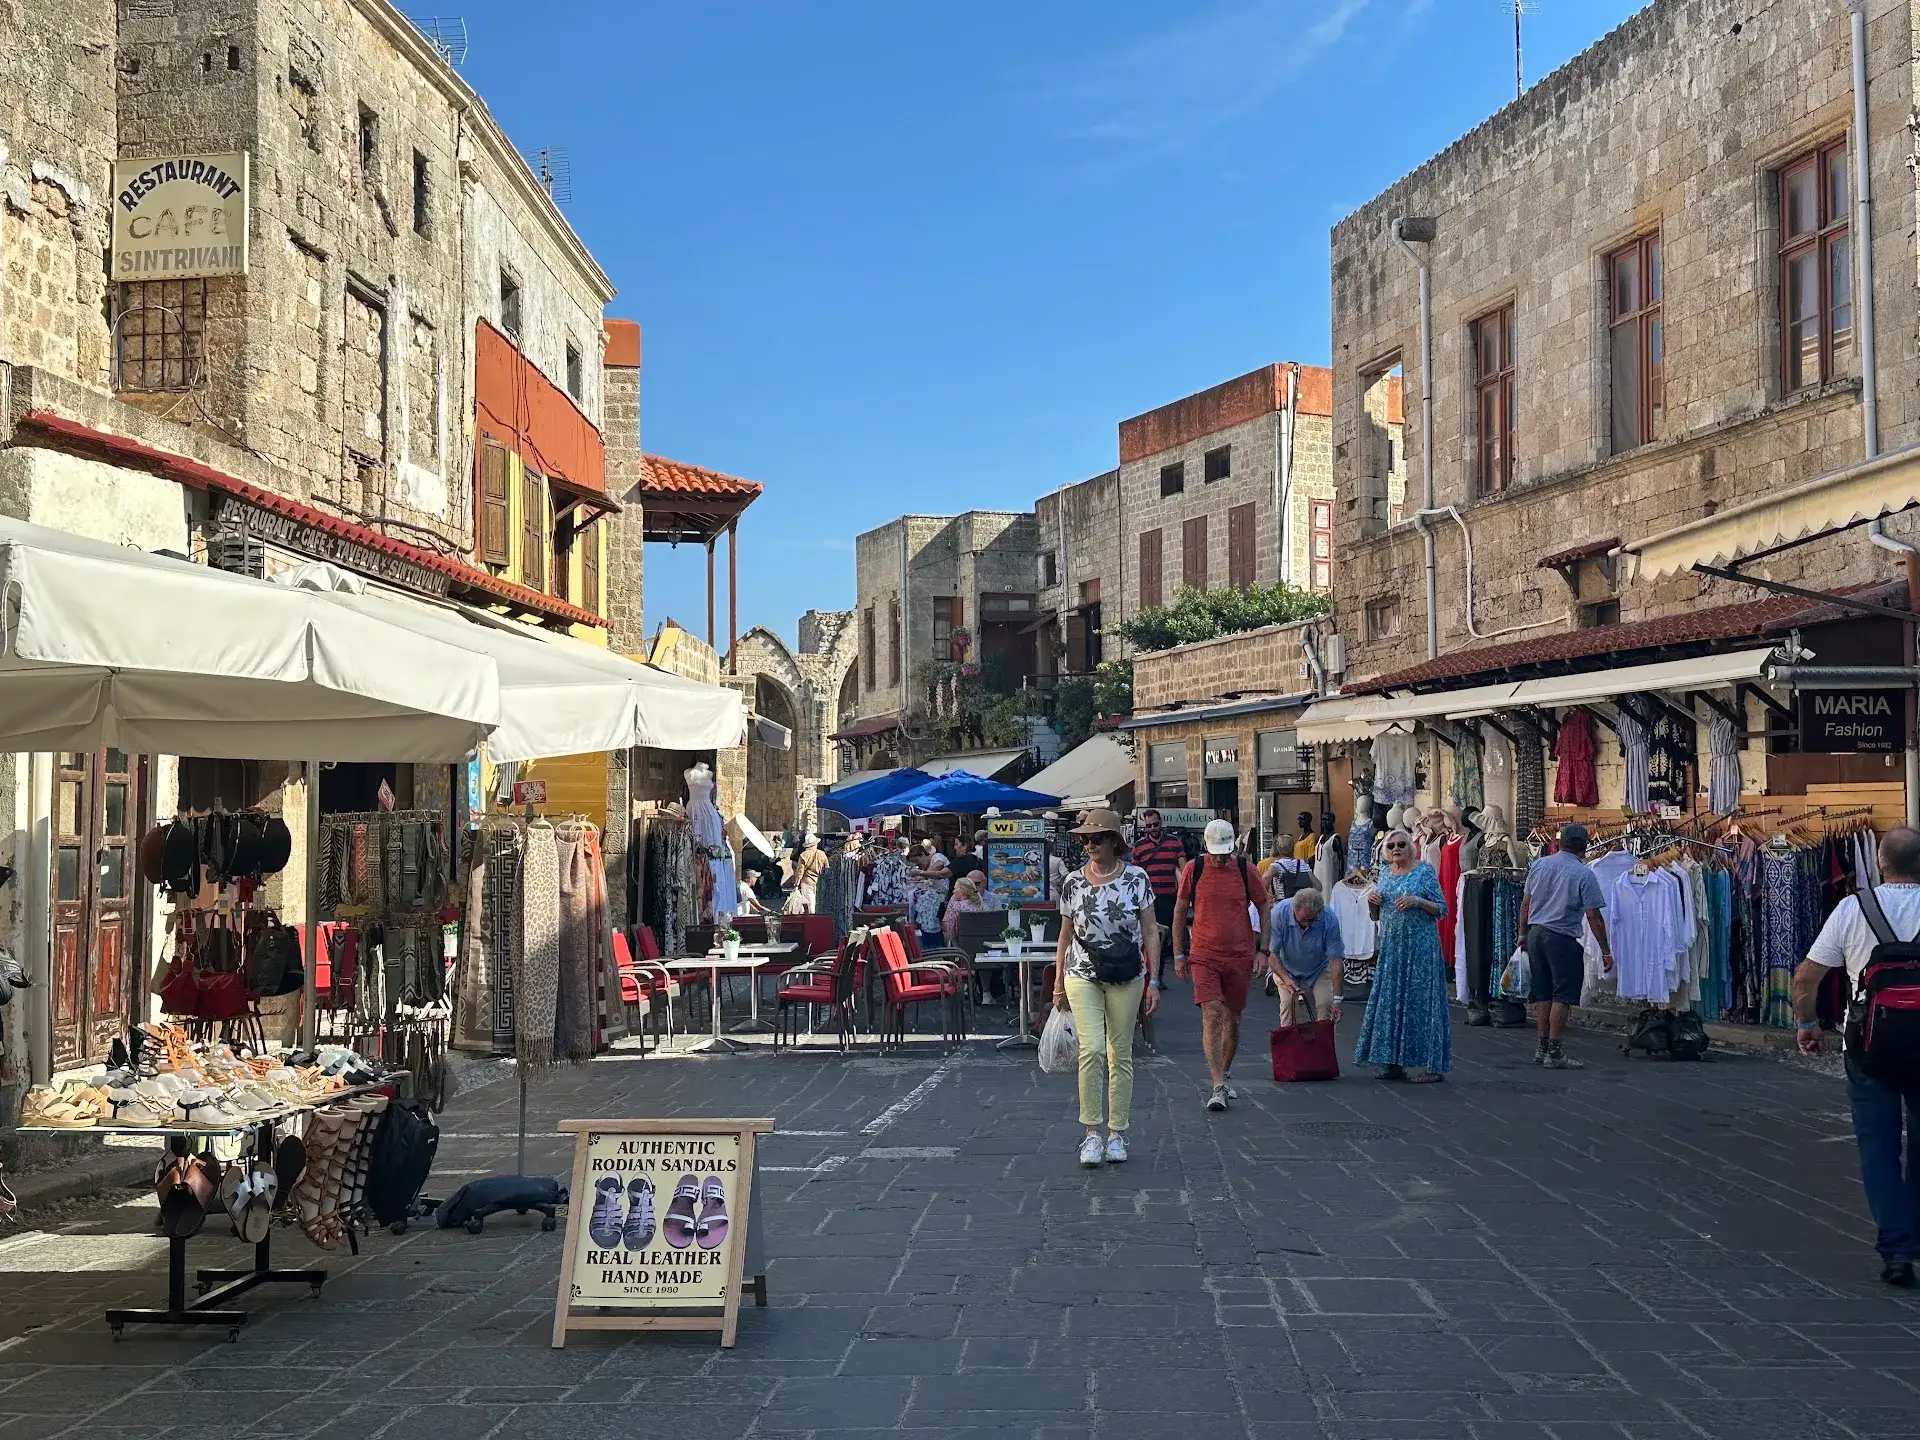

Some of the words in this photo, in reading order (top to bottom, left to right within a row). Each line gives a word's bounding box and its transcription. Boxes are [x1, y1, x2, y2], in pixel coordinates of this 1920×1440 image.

[118, 159, 241, 213] RESTAURANT
[223, 498, 298, 541] RESTAURANT
[301, 527, 328, 551] CAFE
[336, 539, 381, 570] TAVERNA
[1815, 695, 1892, 715] MARIA
[1825, 722, 1883, 737] Fashion
[1176, 813, 1213, 823] Addicts
[617, 1140, 715, 1155] AUTHENTIC
[592, 1158, 655, 1172] RODIAN
[661, 1159, 737, 1172] SANDALS
[586, 1250, 633, 1265] REAL
[640, 1250, 721, 1265] LEATHER
[601, 1270, 649, 1284] HAND
[655, 1270, 703, 1284] MADE
[623, 1286, 653, 1294] SINCE
